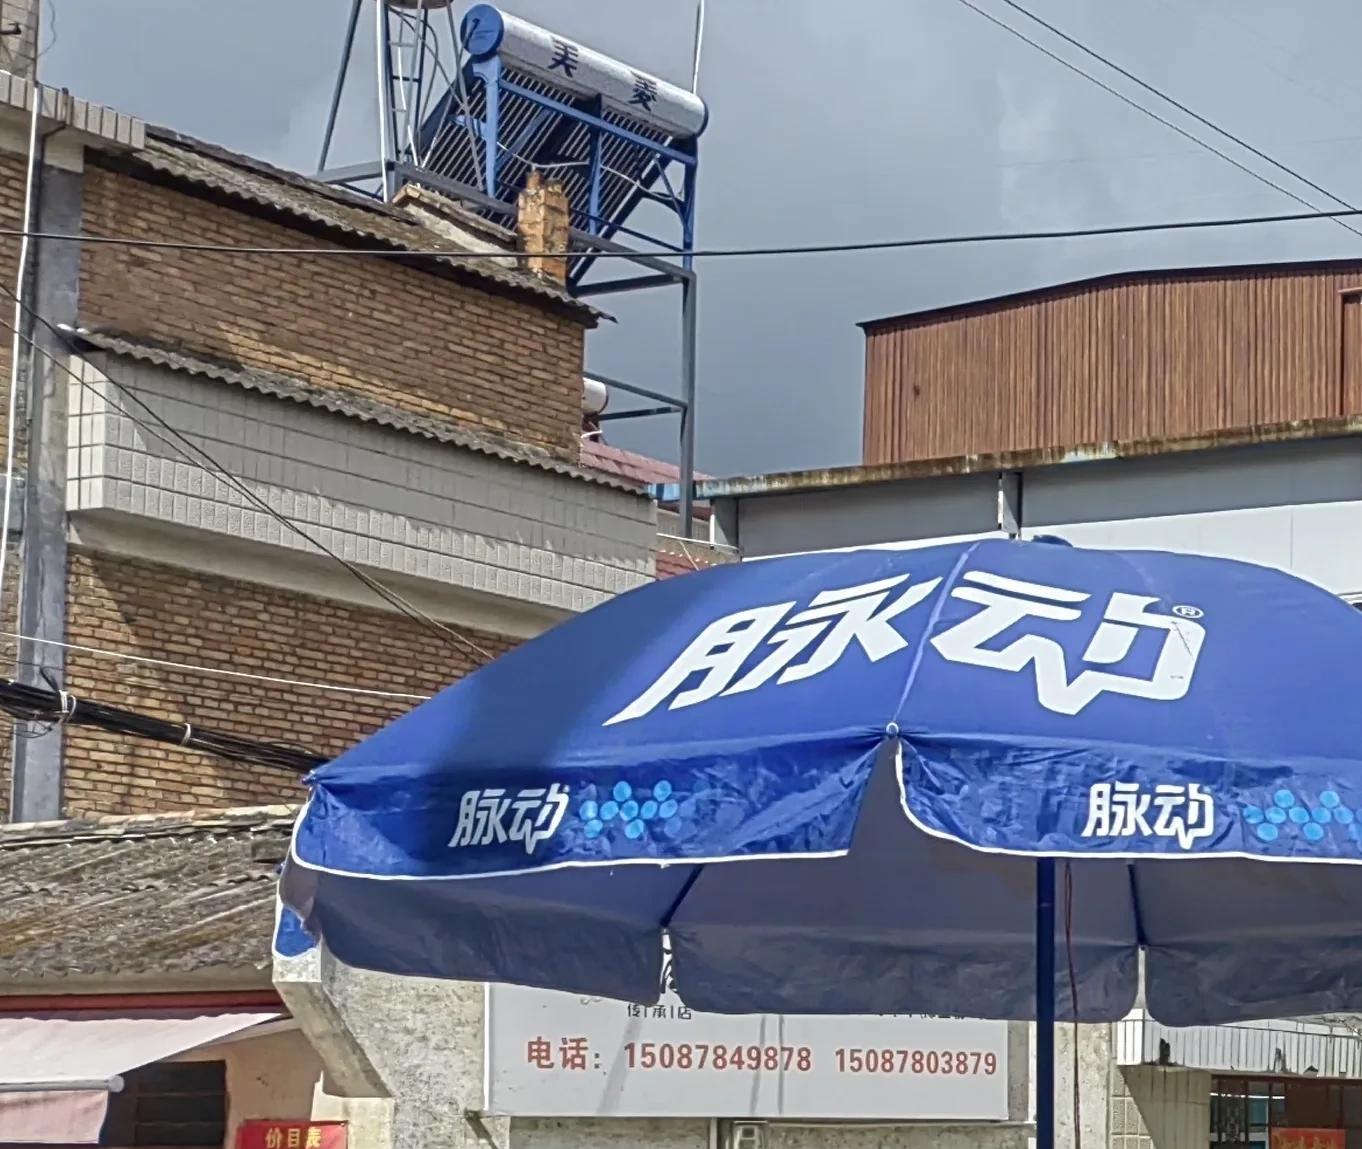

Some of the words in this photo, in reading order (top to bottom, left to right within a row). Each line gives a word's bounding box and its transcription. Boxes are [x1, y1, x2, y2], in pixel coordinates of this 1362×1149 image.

[602, 570, 1206, 726] 脉动
[447, 782, 570, 855] 脉动
[1081, 780, 1214, 850] 脉动
[623, 1041, 813, 1072] 15087849878
[834, 1047, 998, 1077] 15087803879
[265, 1126, 322, 1149] 价目表
